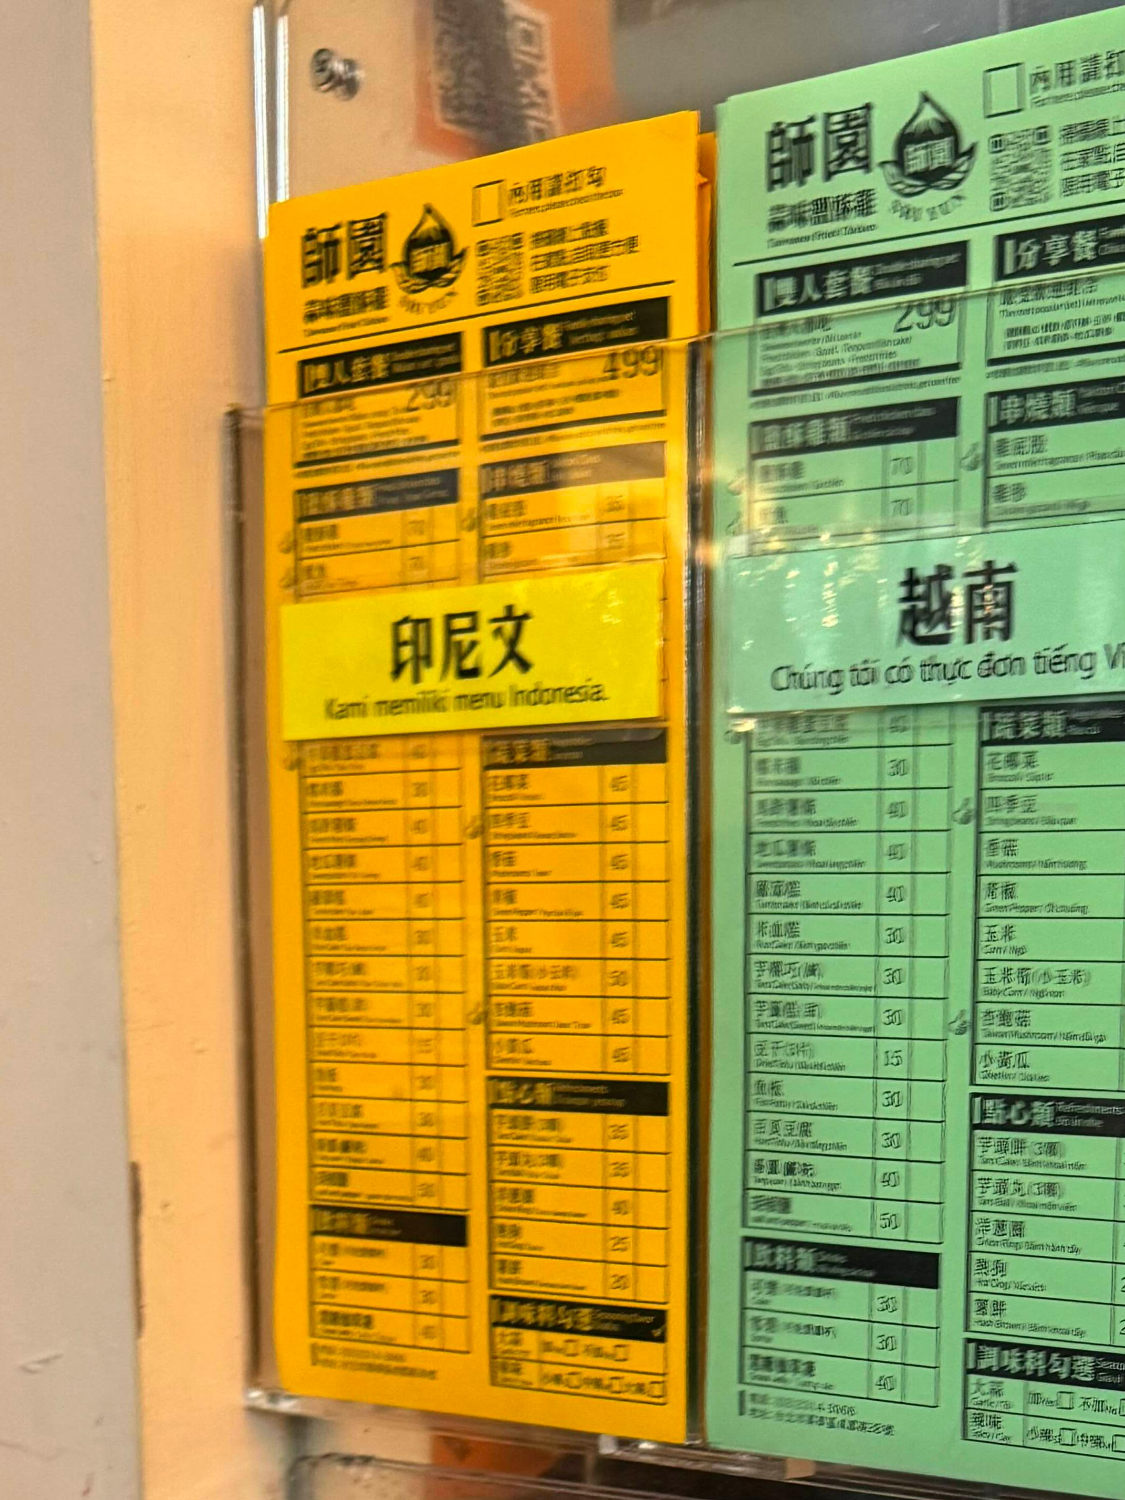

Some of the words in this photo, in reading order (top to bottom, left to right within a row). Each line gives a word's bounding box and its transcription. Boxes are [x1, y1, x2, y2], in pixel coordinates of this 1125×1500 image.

[766, 102, 877, 193] 師園
[389, 604, 535, 684] 印尼文
[896, 559, 1018, 648] 越南
[885, 655, 914, 684] có
